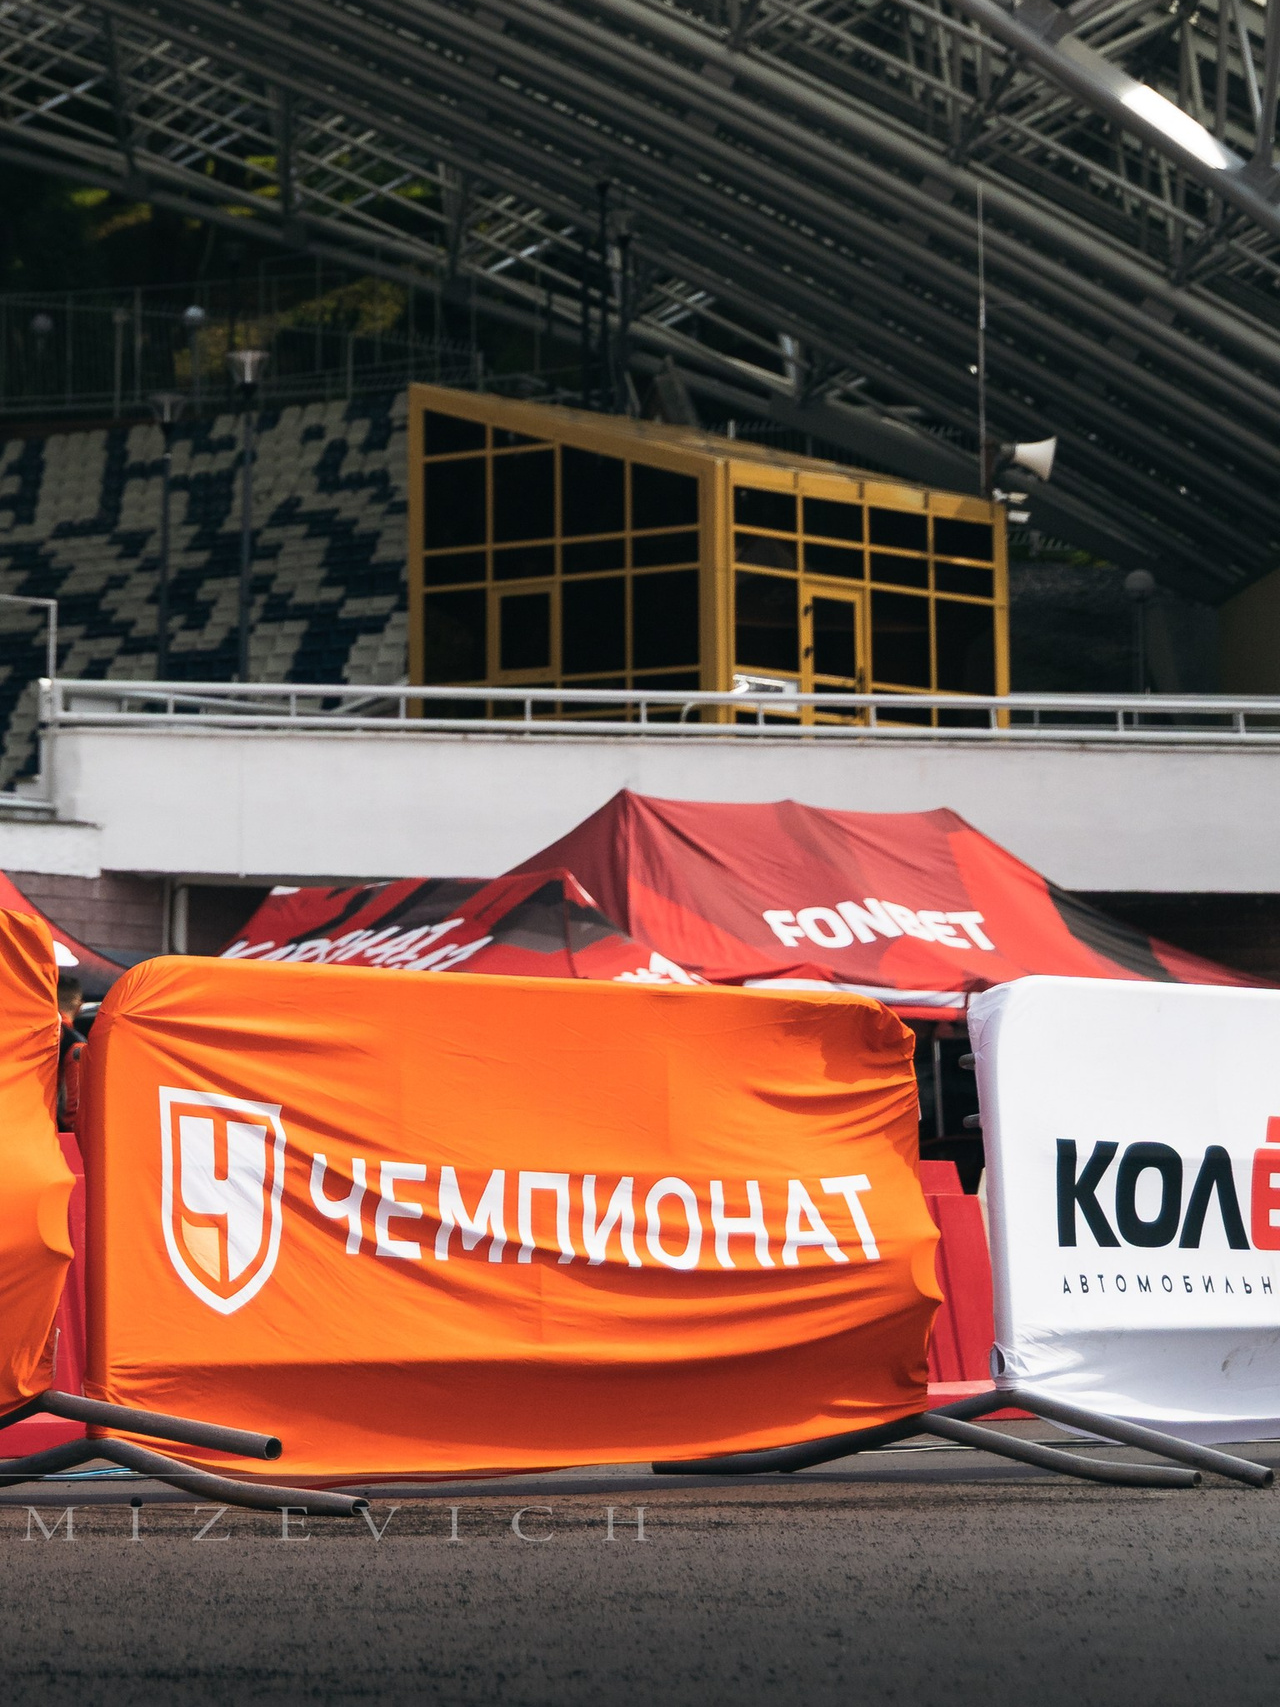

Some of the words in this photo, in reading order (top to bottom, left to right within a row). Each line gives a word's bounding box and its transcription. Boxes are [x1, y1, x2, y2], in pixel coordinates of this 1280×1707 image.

[762, 897, 996, 951] FONBET
[308, 1152, 880, 1270] ЧЕМПИОНАТ
[1062, 1273, 1274, 1295] АВТОМОБИЛЬН
